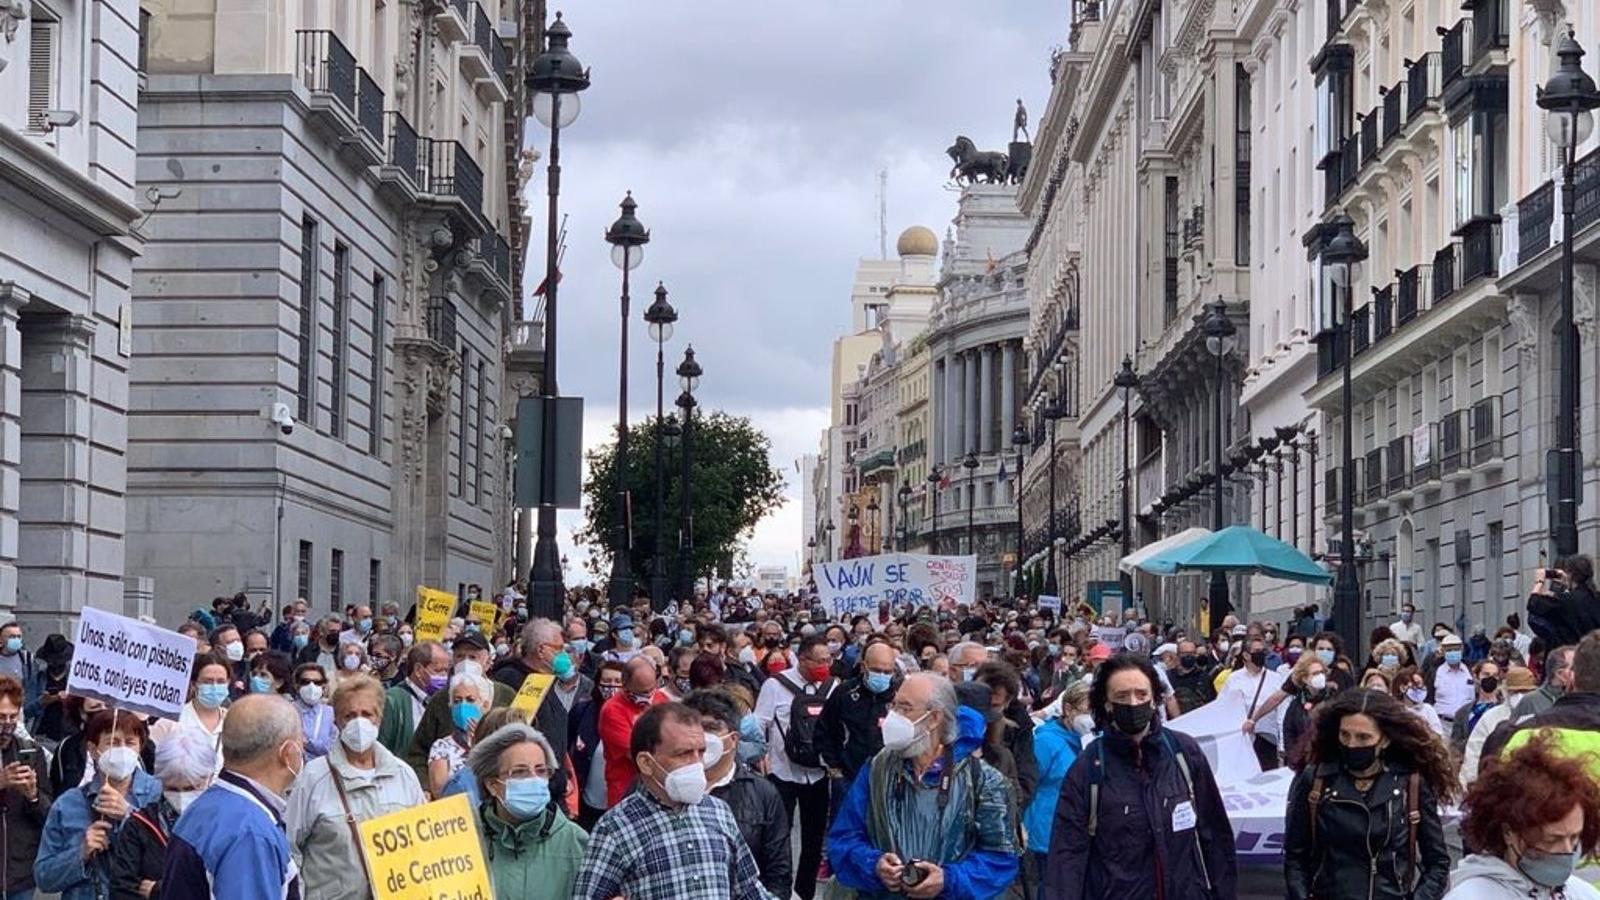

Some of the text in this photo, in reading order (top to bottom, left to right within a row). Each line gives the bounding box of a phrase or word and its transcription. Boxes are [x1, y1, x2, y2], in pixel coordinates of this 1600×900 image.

[885, 563, 910, 583] SE
[832, 594, 879, 614] PUEDE
[80, 621, 190, 678] Unos, sólo con pistolas,
[74, 659, 102, 687] otros,
[149, 679, 182, 704] roban.
[372, 815, 468, 857] SOS! Cierre
[387, 868, 407, 893] de
[409, 854, 473, 884] Centros
